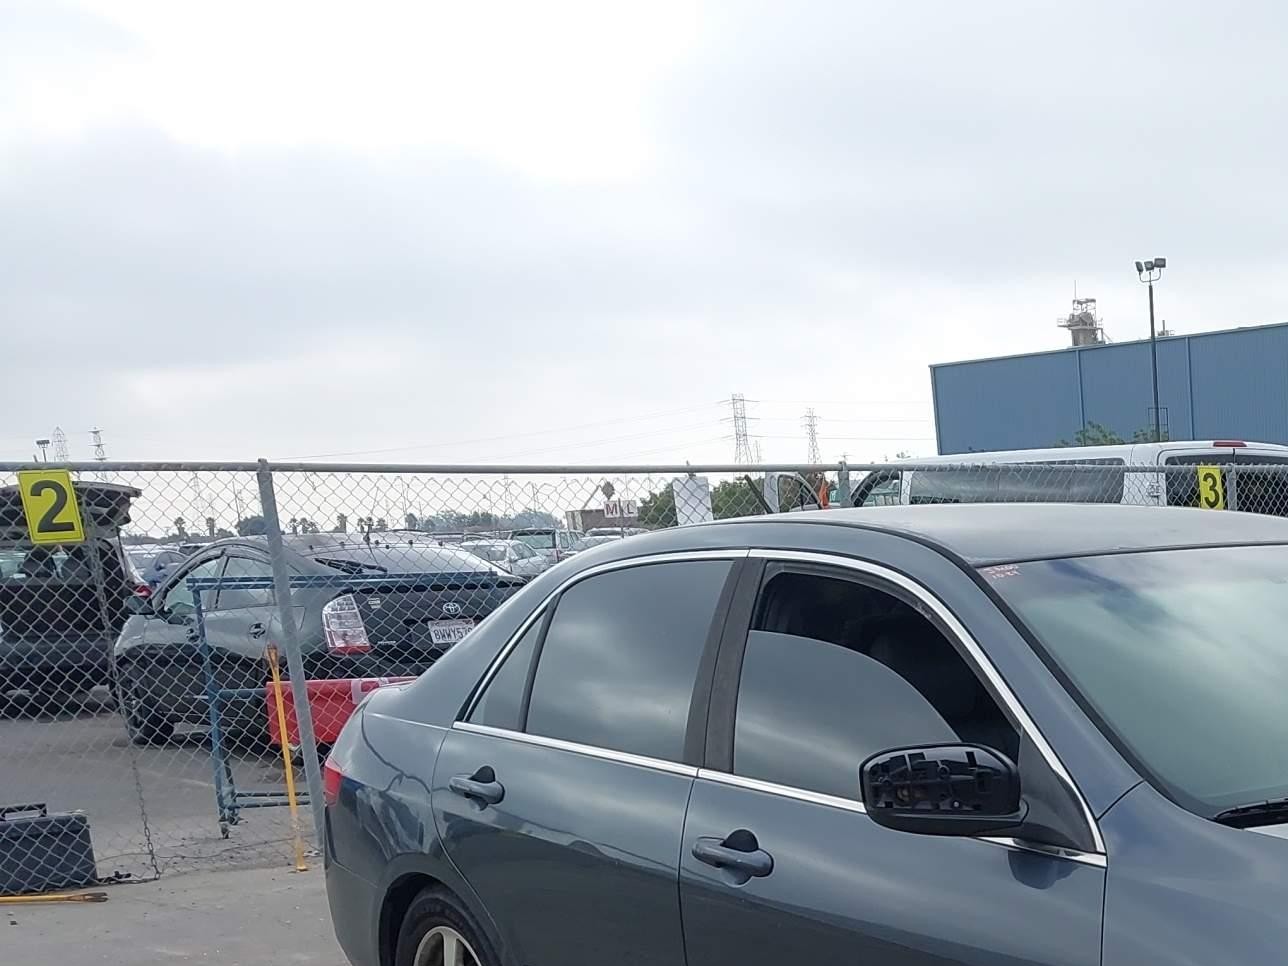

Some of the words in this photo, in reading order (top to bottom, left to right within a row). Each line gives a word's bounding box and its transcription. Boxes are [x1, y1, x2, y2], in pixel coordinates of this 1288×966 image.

[30, 480, 75, 533] 2
[1203, 473, 1219, 508] 3
[605, 503, 617, 516] M
